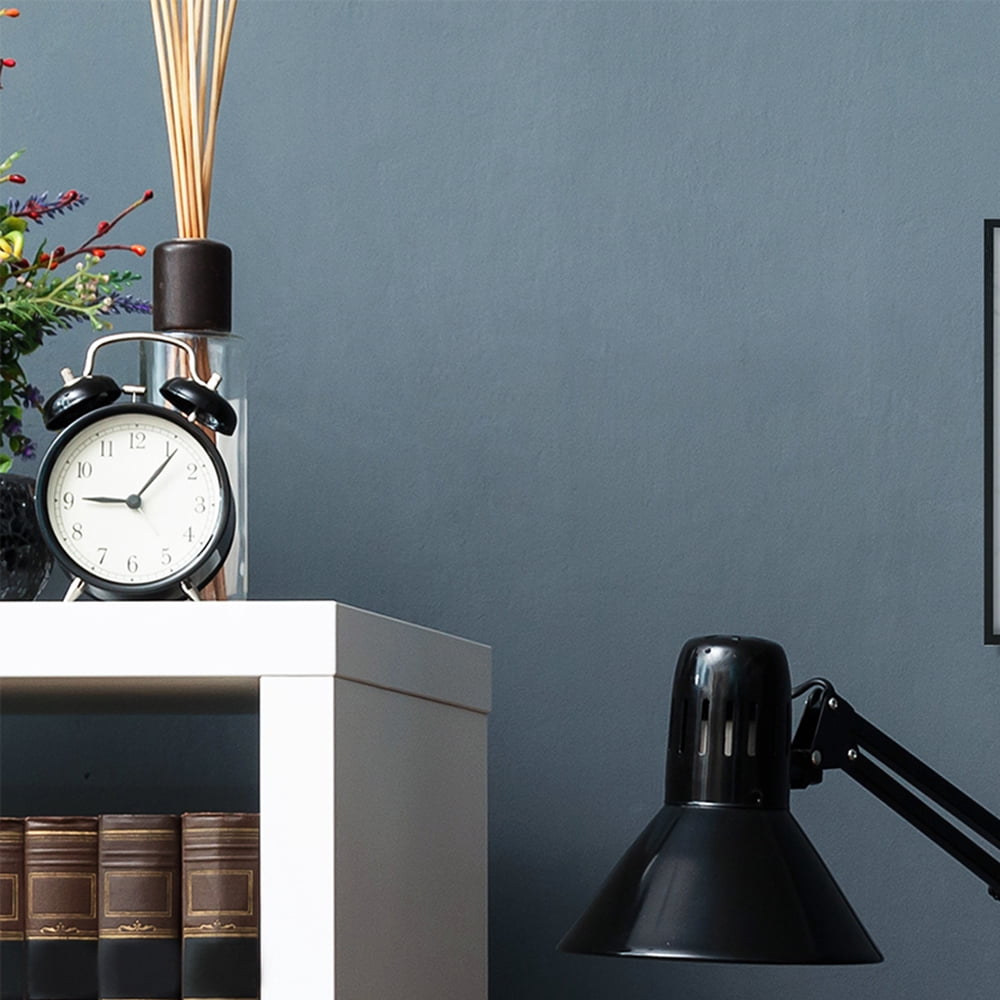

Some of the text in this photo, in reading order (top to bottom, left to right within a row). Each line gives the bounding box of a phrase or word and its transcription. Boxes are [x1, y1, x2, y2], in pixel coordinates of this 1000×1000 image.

[99, 440, 113, 458] 11
[129, 432, 147, 450] 12
[77, 461, 93, 479] 10
[186, 463, 198, 481] 2
[62, 492, 75, 511] 9
[194, 496, 207, 514] 3
[71, 522, 84, 541] 8
[183, 526, 195, 543] 4
[97, 547, 108, 565] 7
[126, 555, 139, 573] 6
[161, 547, 172, 565] 5
